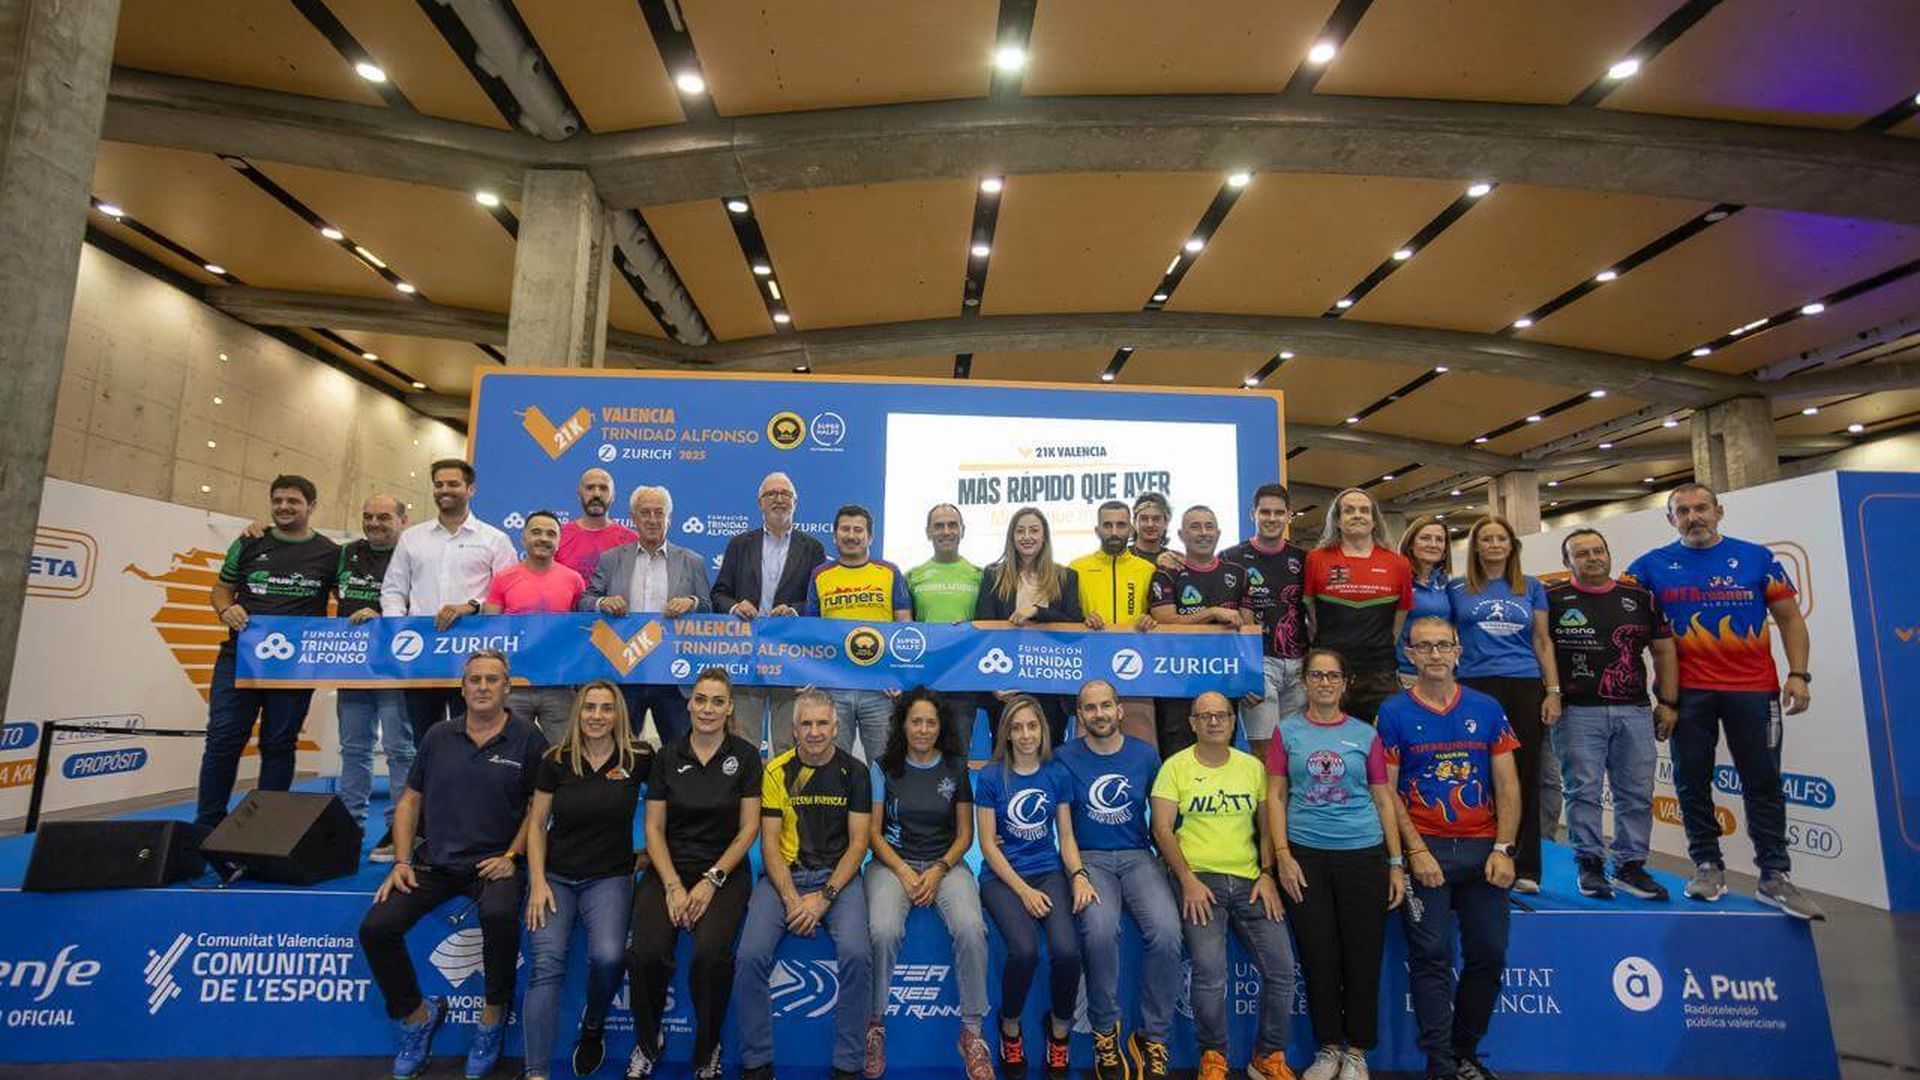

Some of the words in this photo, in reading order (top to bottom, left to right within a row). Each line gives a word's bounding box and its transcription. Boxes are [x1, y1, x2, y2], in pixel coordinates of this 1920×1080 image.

[602, 407, 676, 423] VALENCIA
[553, 418, 585, 451] 21K
[600, 427, 676, 442] TRINIDAD
[681, 430, 759, 444] ALFONSO
[623, 447, 672, 460] ZURICH
[679, 450, 706, 460] 2025
[1036, 447, 1055, 458] 21K
[1057, 446, 1107, 457] VALENCIA
[958, 473, 1000, 505] MÁS
[1007, 471, 1075, 503] RÁPIDO
[1081, 473, 1117, 504] QUE
[1123, 471, 1171, 498] AYER
[706, 528, 747, 536] ALFONSO
[707, 521, 748, 529] TRINIDAD
[793, 523, 834, 533] ZURIC
[31, 556, 77, 578] ETA
[824, 592, 884, 609] runners
[303, 630, 370, 638] FUNDACIÓN
[673, 619, 751, 637] VALENCIA
[300, 640, 368, 652] TRINIDAD
[433, 635, 519, 654] ZURICH
[622, 630, 657, 667] 21K
[672, 640, 751, 657] TRINIDAD
[757, 642, 837, 659] ALFONSO
[1018, 644, 1082, 655] FUNDACIÓN
[298, 652, 367, 664] ALFONSO
[1018, 655, 1083, 668] TRINIDAD
[1154, 656, 1239, 674] ZURICH
[697, 662, 749, 675] ZICH
[1018, 667, 1083, 680] ALFONSO
[1806, 829, 1833, 851] GO
[197, 933, 273, 948] Comunitat
[278, 933, 354, 949] Valenciana
[192, 952, 353, 976] COMUNITAT
[0, 944, 101, 1002] nfe
[892, 965, 950, 982] FEA
[200, 979, 237, 1002] DE
[244, 978, 371, 1003] L'ESPORT
[1682, 969, 1704, 1000] À
[1711, 974, 1778, 1001] Punt
[446, 995, 488, 1009] WOR
[887, 986, 941, 1004] RIES
[8, 1009, 75, 1027] OFICIAL
[905, 1004, 991, 1020] RUNN
[1684, 1004, 1759, 1016] Radiotelevisió
[1686, 1016, 1726, 1029] pública
[1727, 1018, 1786, 1030] valenciana
